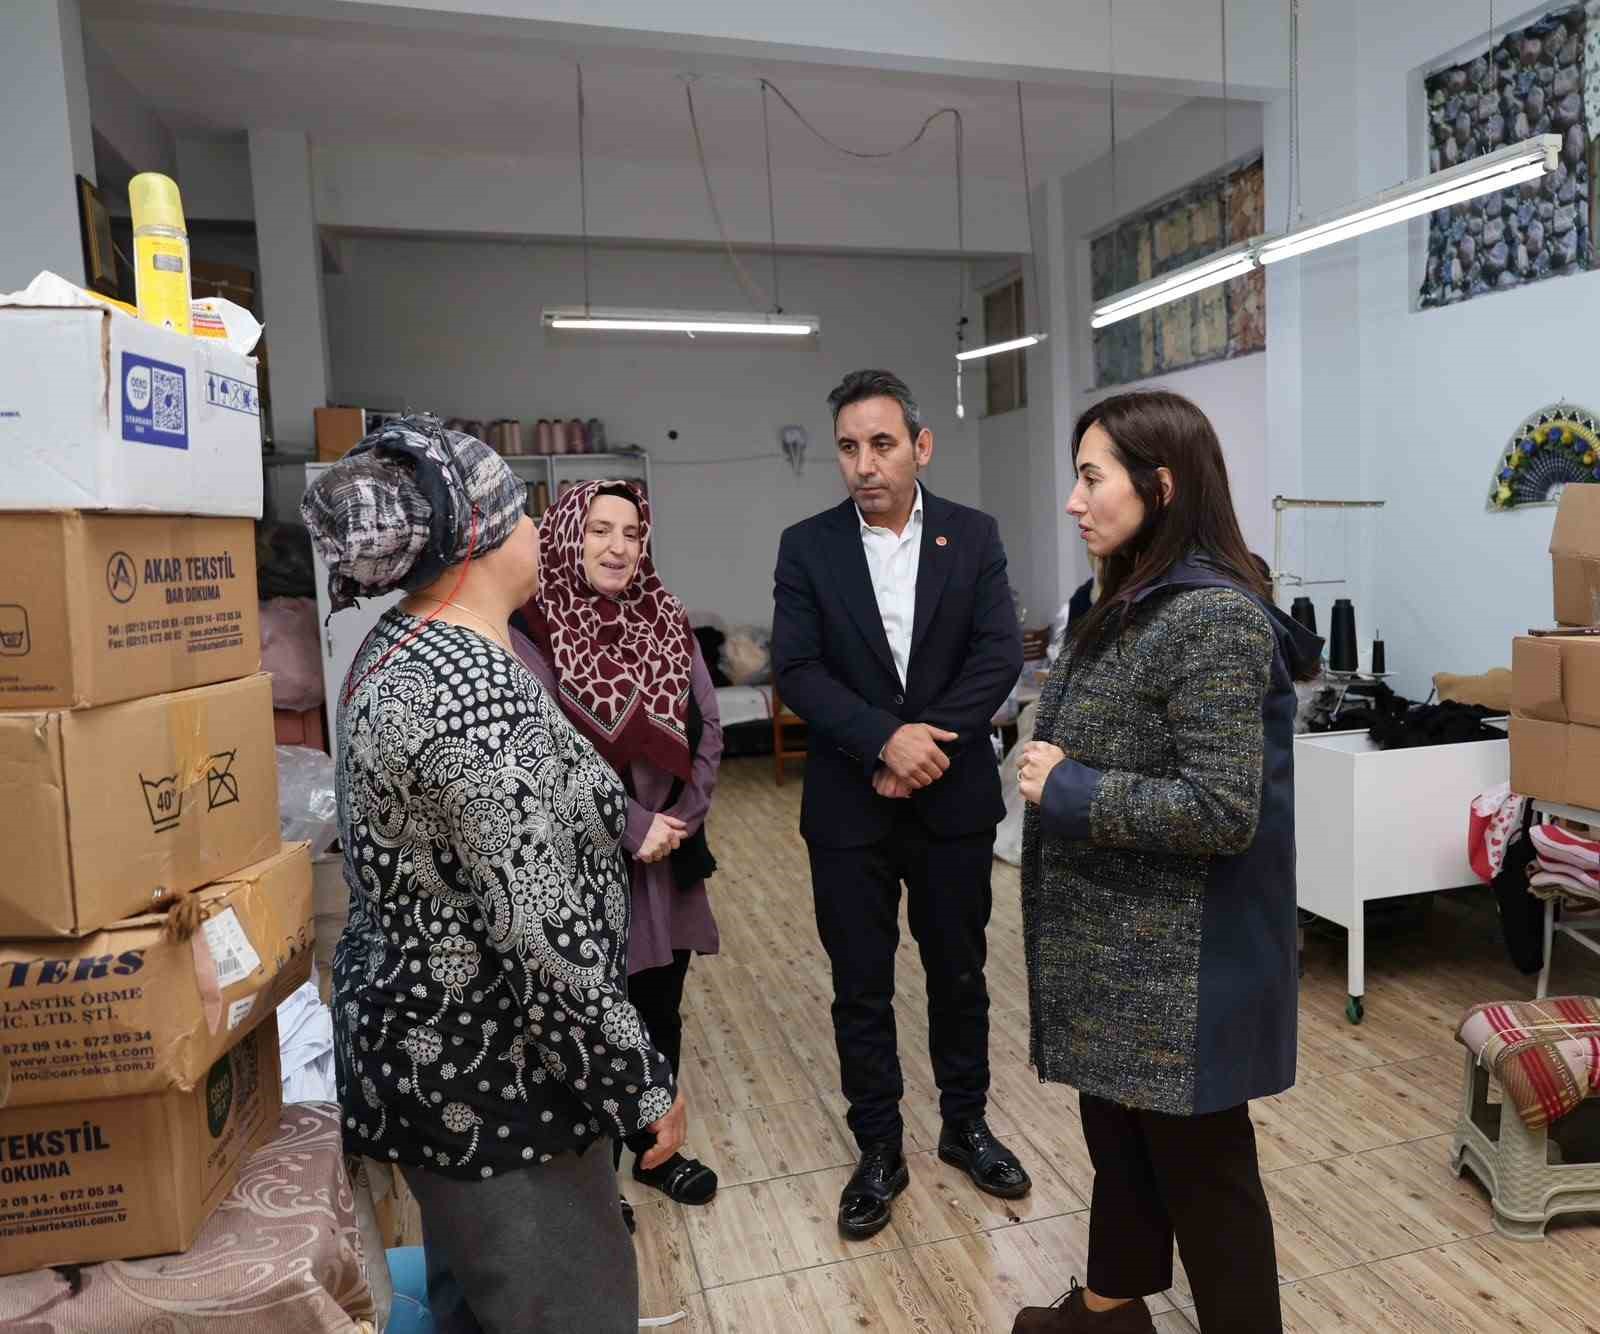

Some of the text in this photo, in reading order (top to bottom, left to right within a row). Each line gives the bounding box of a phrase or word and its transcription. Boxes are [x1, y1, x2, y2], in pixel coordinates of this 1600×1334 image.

[144, 551, 236, 584] AKAR TEKSTİL
[0, 949, 147, 988] TEKS
[4, 987, 144, 1013] LASTİK ÖRME
[0, 1004, 119, 1030] İC. LTD. ŞTİ.
[83, 1035, 110, 1047] 672
[134, 1031, 152, 1042] 34
[9, 1045, 155, 1069] www.can-teks.com
